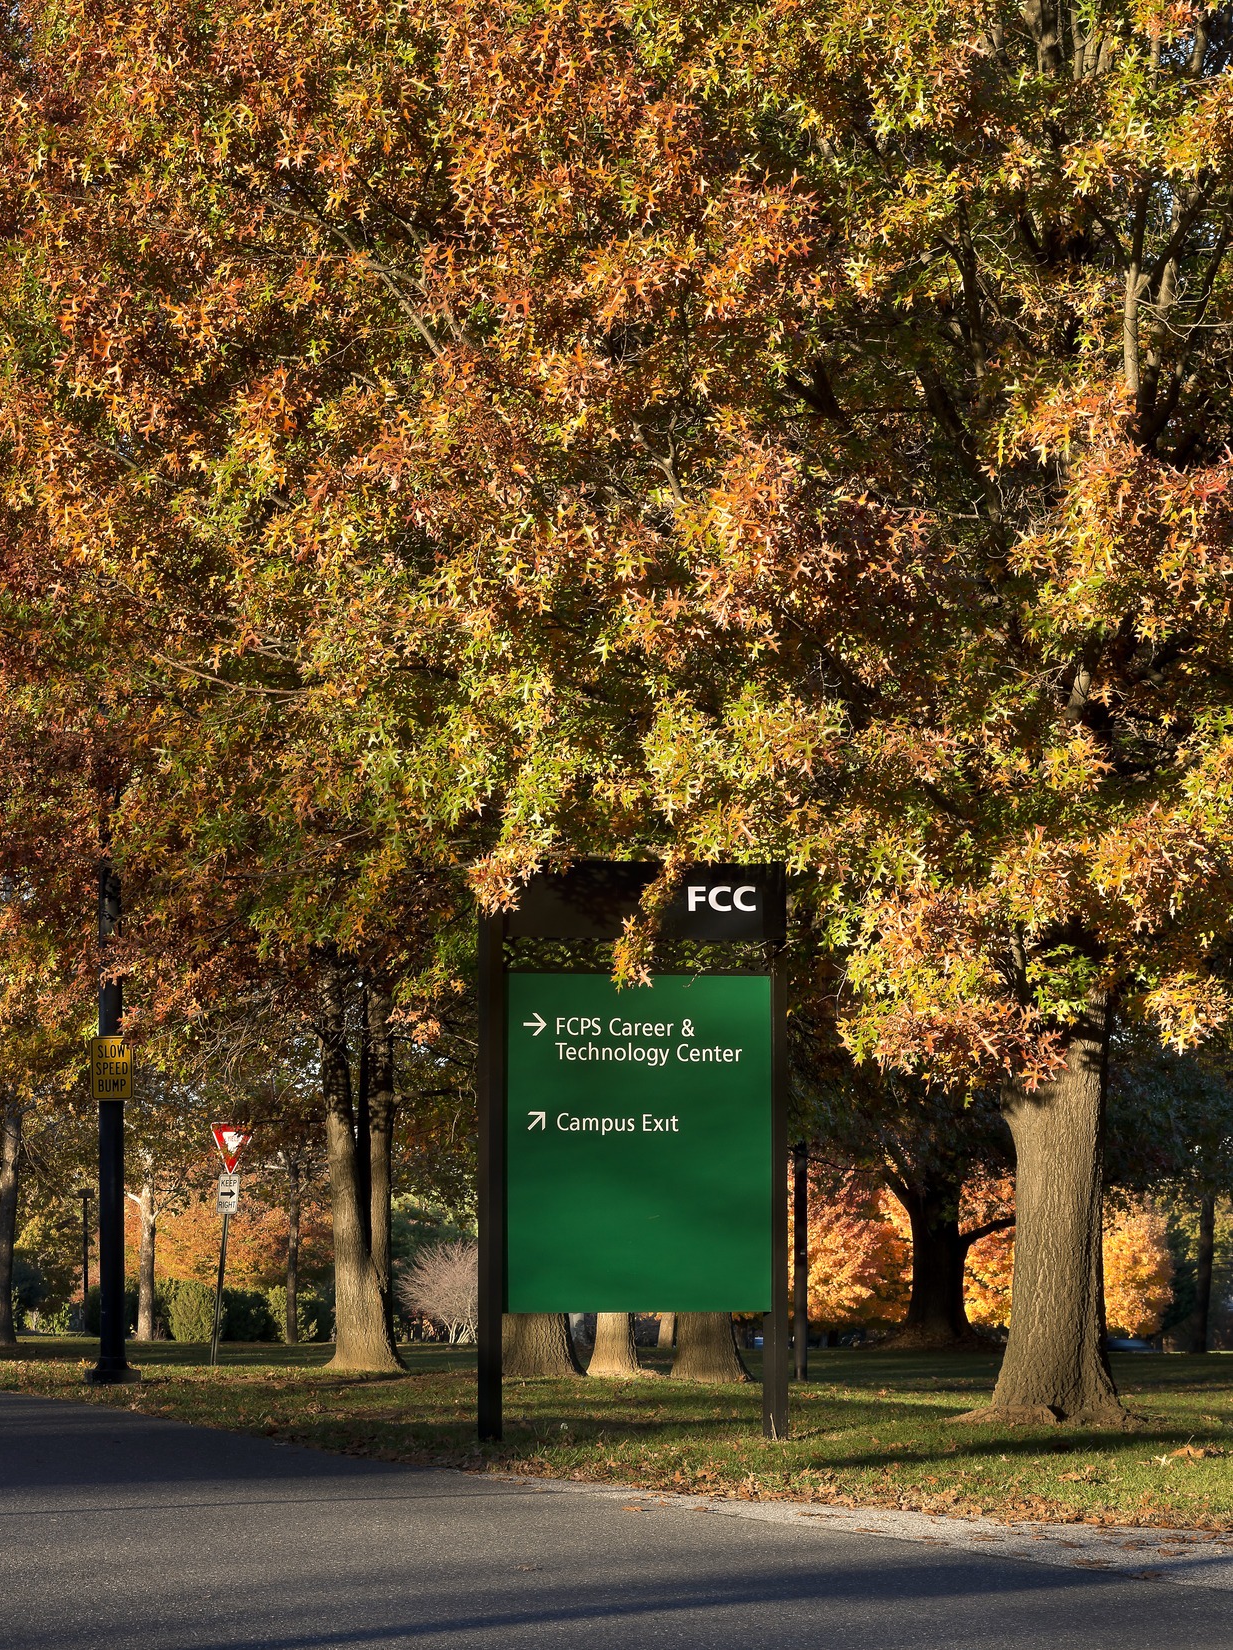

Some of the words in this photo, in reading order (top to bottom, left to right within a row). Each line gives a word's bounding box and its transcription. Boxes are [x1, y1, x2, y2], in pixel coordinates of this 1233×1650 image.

[687, 886, 757, 912] FCC
[555, 1017, 602, 1036] FCPS
[608, 1017, 675, 1037] Career
[681, 1018, 696, 1037] &
[97, 1044, 127, 1059] SLOW
[554, 1041, 670, 1067] Technology
[676, 1043, 743, 1063] Center
[95, 1061, 129, 1076] SPEED
[97, 1079, 127, 1093] BUMP
[556, 1112, 635, 1136] Campus
[642, 1113, 680, 1133] Exit
[220, 1179, 238, 1188] KEEP
[218, 1200, 237, 1209] RIGHT
